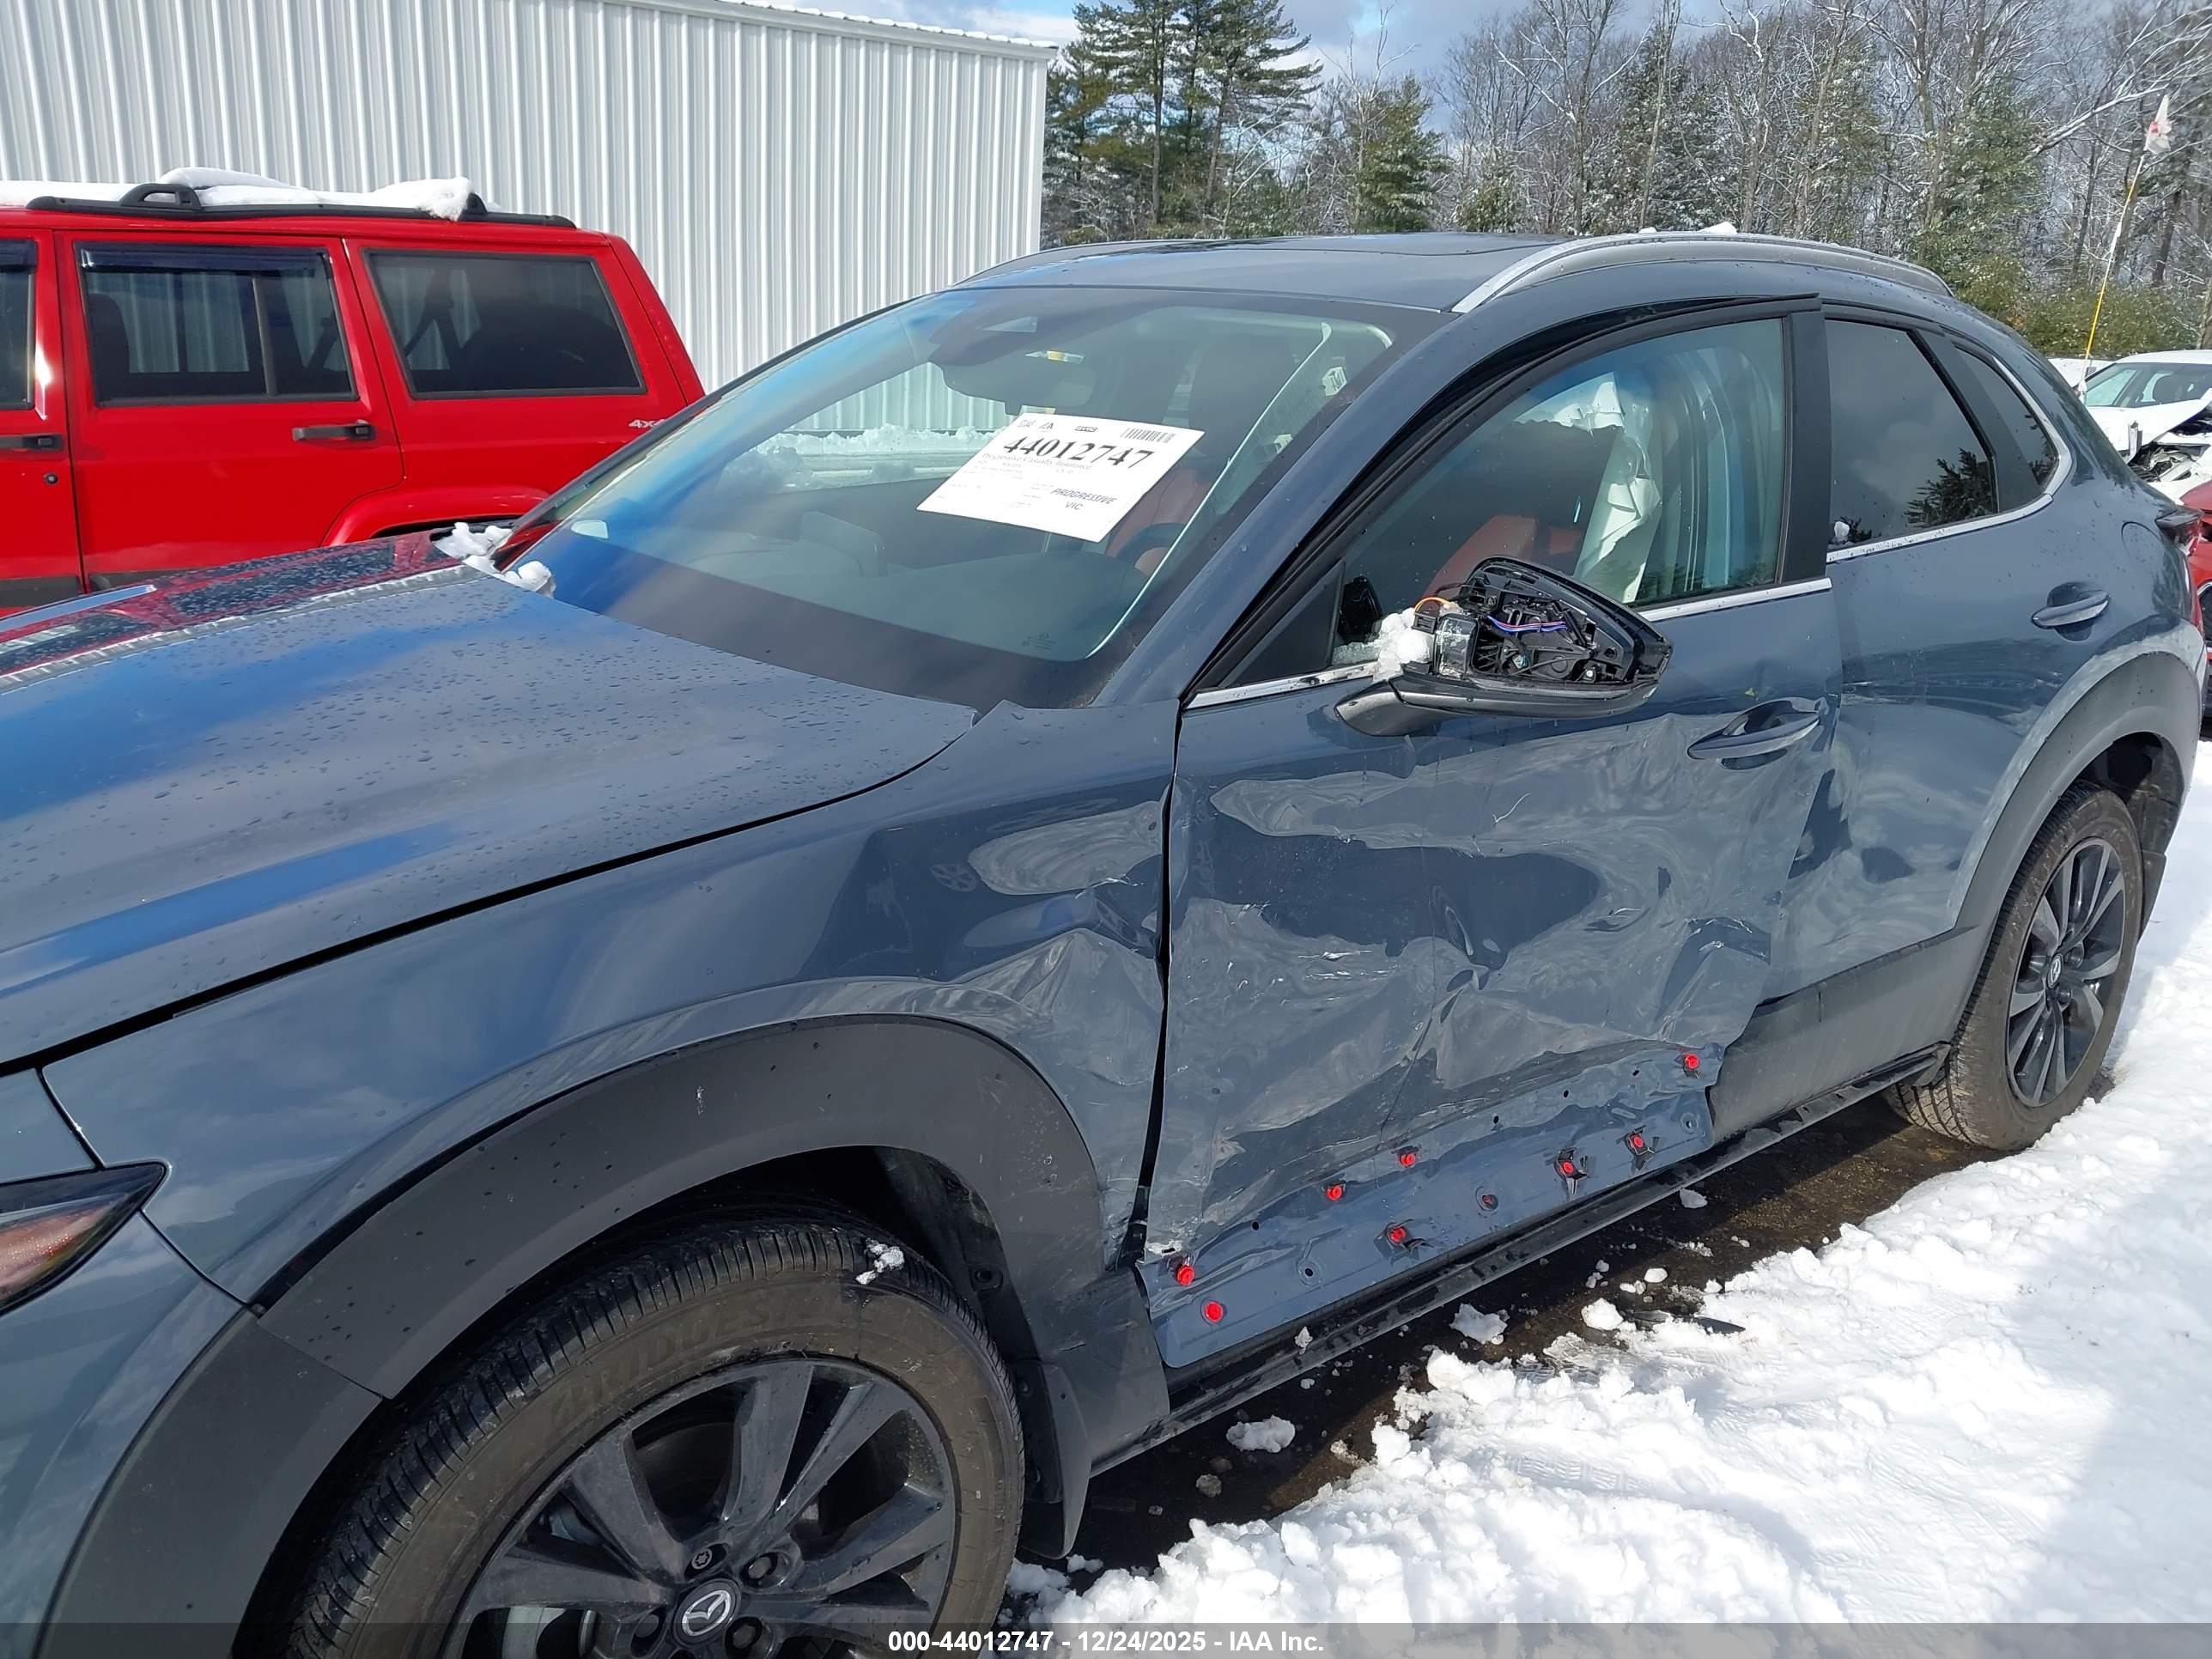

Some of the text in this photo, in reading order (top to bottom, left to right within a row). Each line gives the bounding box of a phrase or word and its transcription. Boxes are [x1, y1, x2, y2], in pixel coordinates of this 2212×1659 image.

[1003, 436, 1155, 469] 44012747
[1050, 488, 1118, 505] PROGRESSIVE
[1065, 501, 1085, 511] VIC
